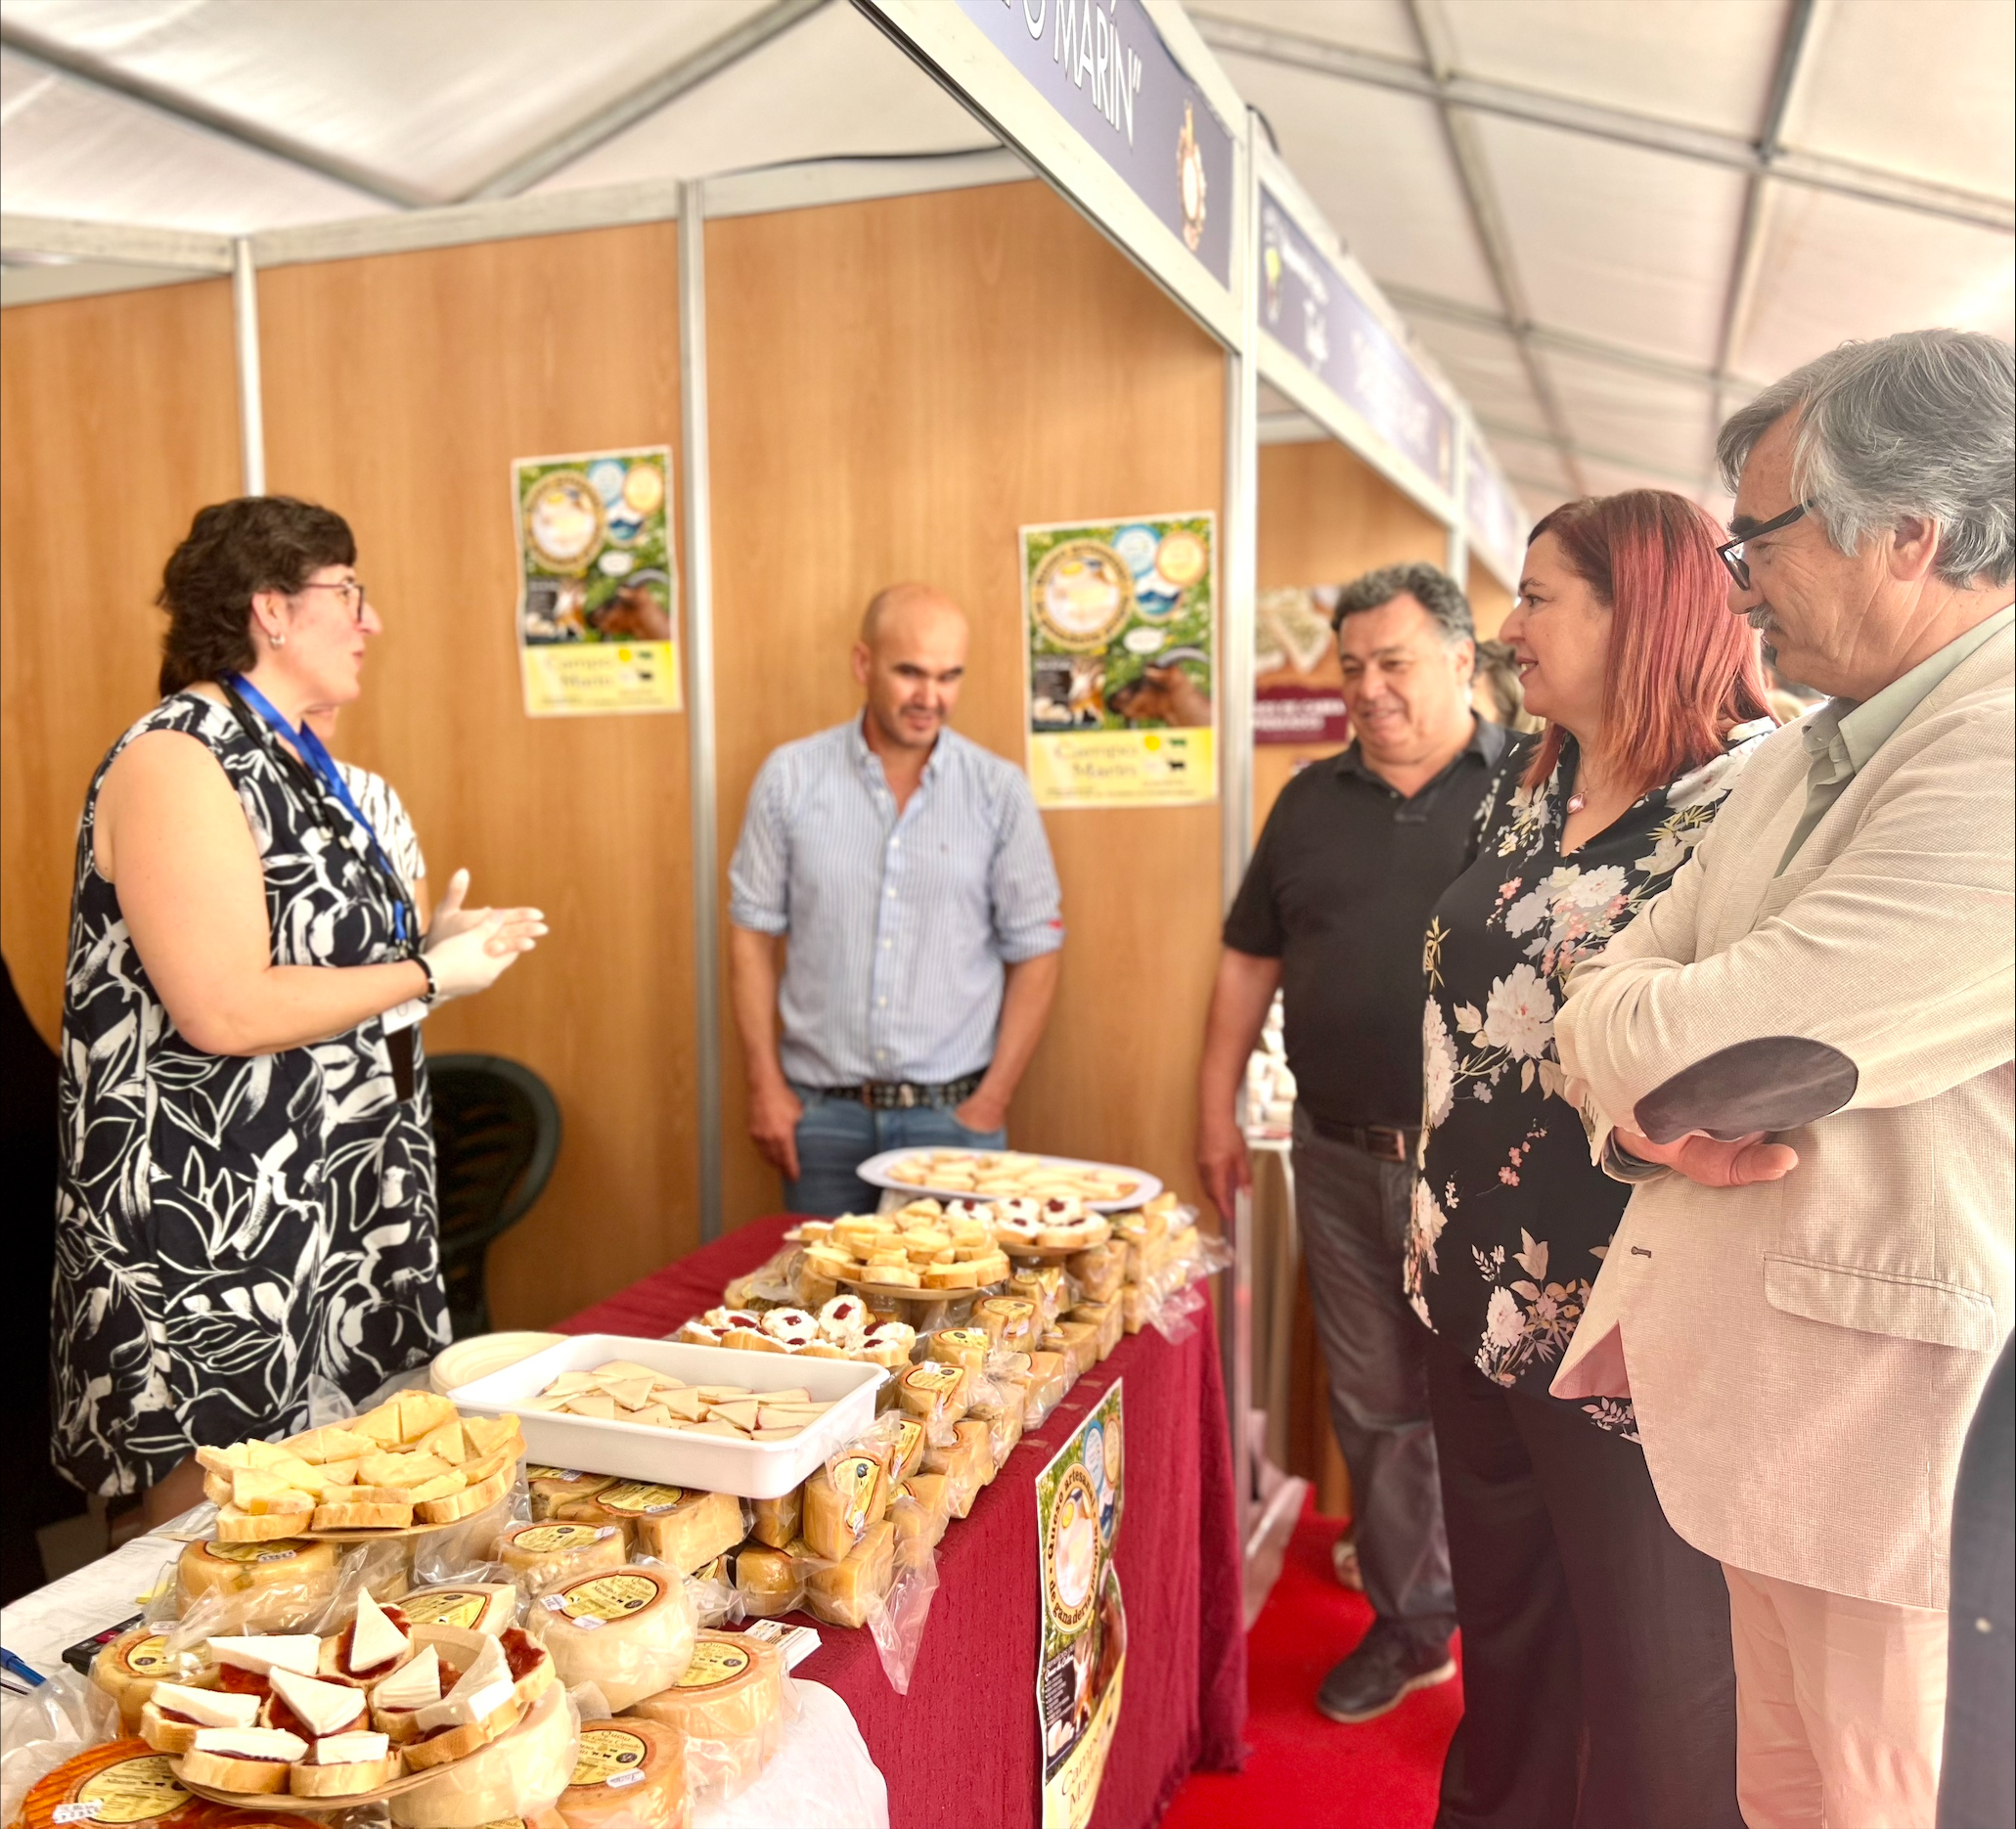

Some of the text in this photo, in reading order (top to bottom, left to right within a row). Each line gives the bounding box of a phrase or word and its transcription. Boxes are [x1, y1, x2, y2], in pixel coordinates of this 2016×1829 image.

[1047, 1490, 1064, 1560] Queso
[1063, 1469, 1097, 1507] artesanal
[1049, 1580, 1056, 1603] de
